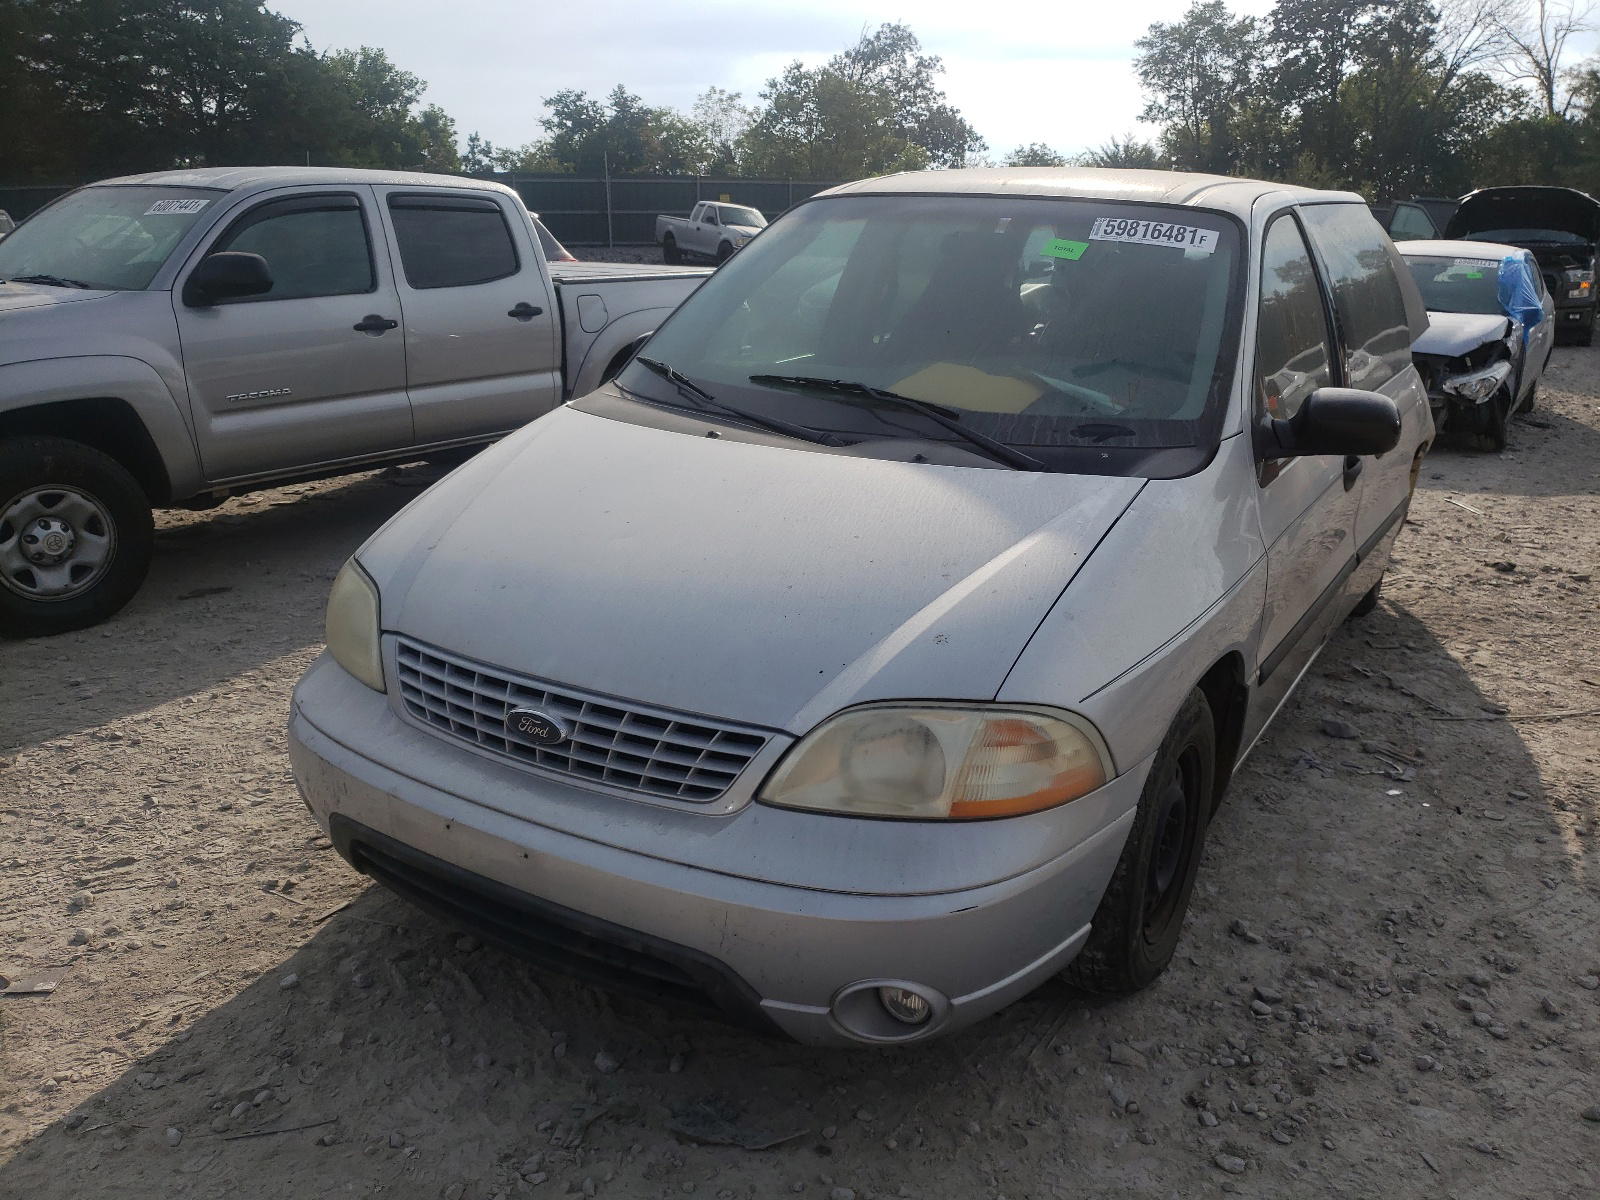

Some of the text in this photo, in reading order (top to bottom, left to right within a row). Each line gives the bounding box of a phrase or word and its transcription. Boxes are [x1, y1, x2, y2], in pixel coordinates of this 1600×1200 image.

[1104, 219, 1198, 245] 59816481
[226, 388, 292, 401] TACOMA
[518, 716, 549, 738] Ford
